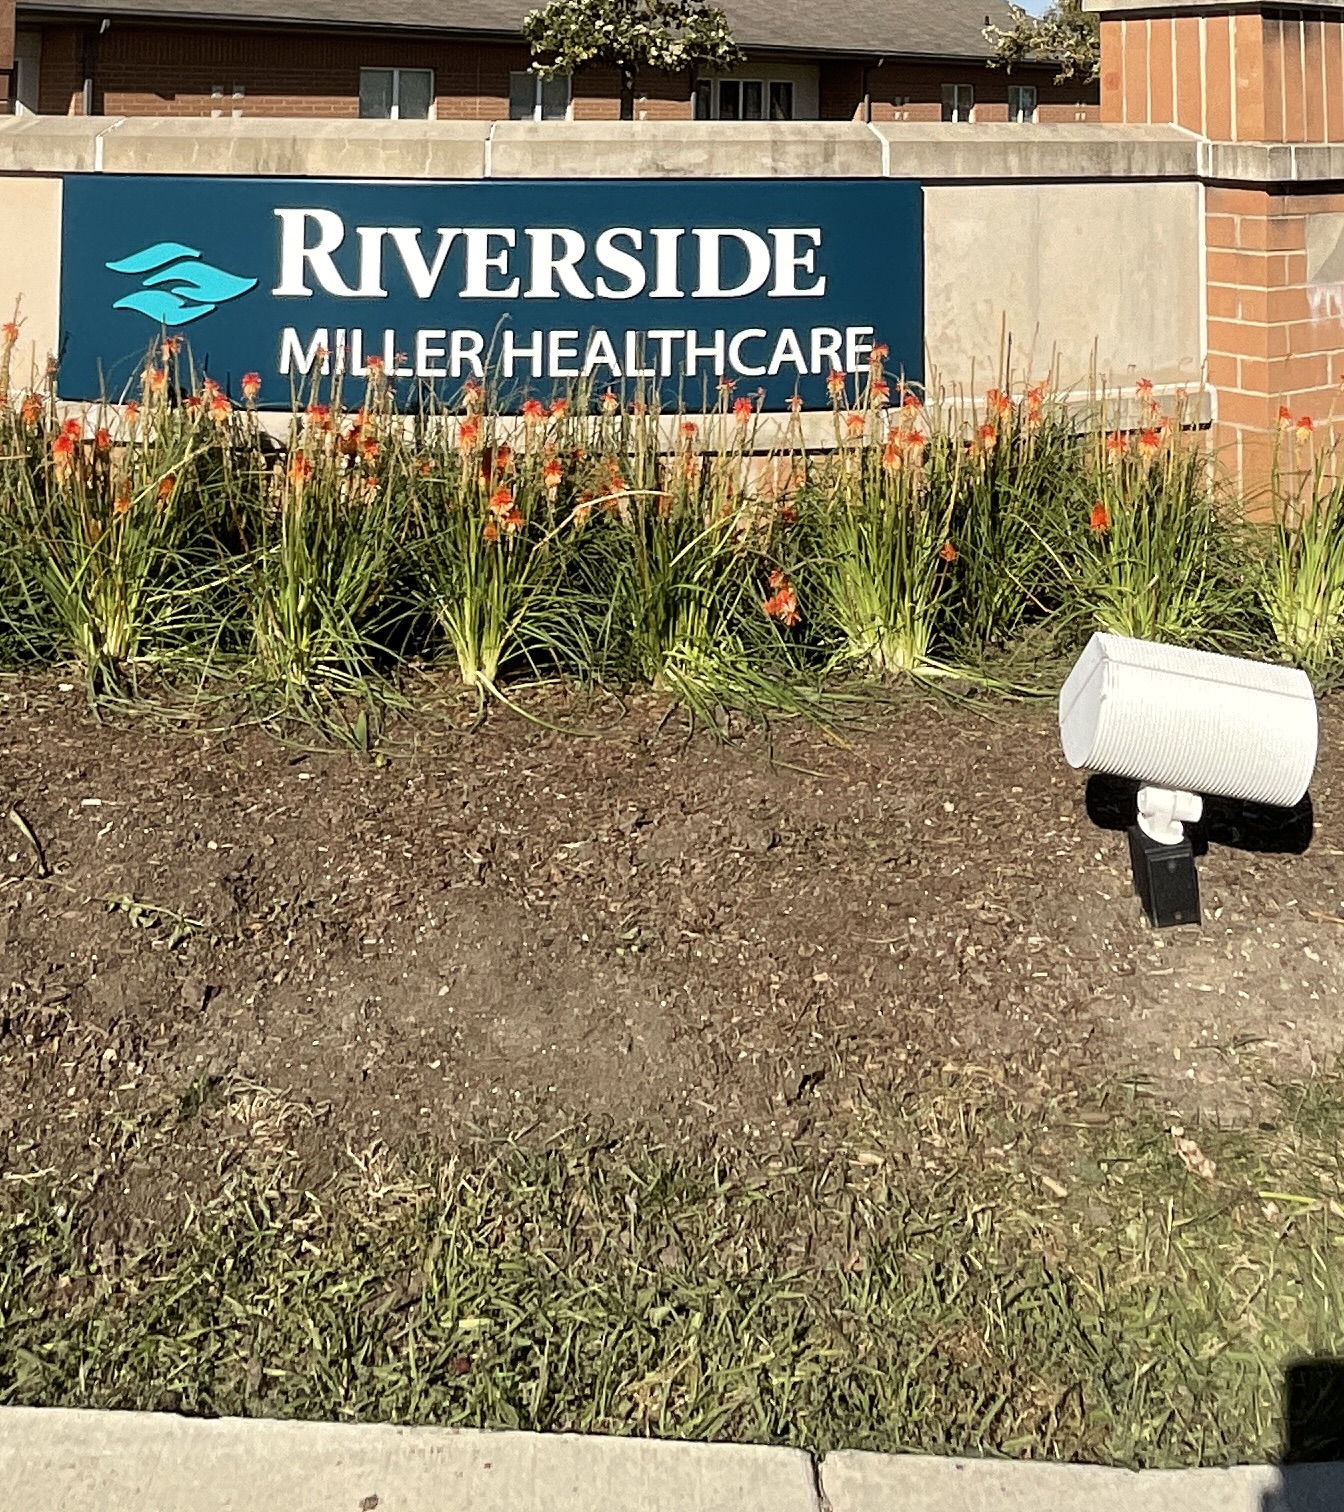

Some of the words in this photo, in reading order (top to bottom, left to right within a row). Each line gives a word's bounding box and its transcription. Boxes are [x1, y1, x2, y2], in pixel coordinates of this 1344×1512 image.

[272, 208, 828, 299] RIVERSIDE
[279, 327, 484, 378] MILLER
[504, 326, 875, 377] HEALTHCARE
